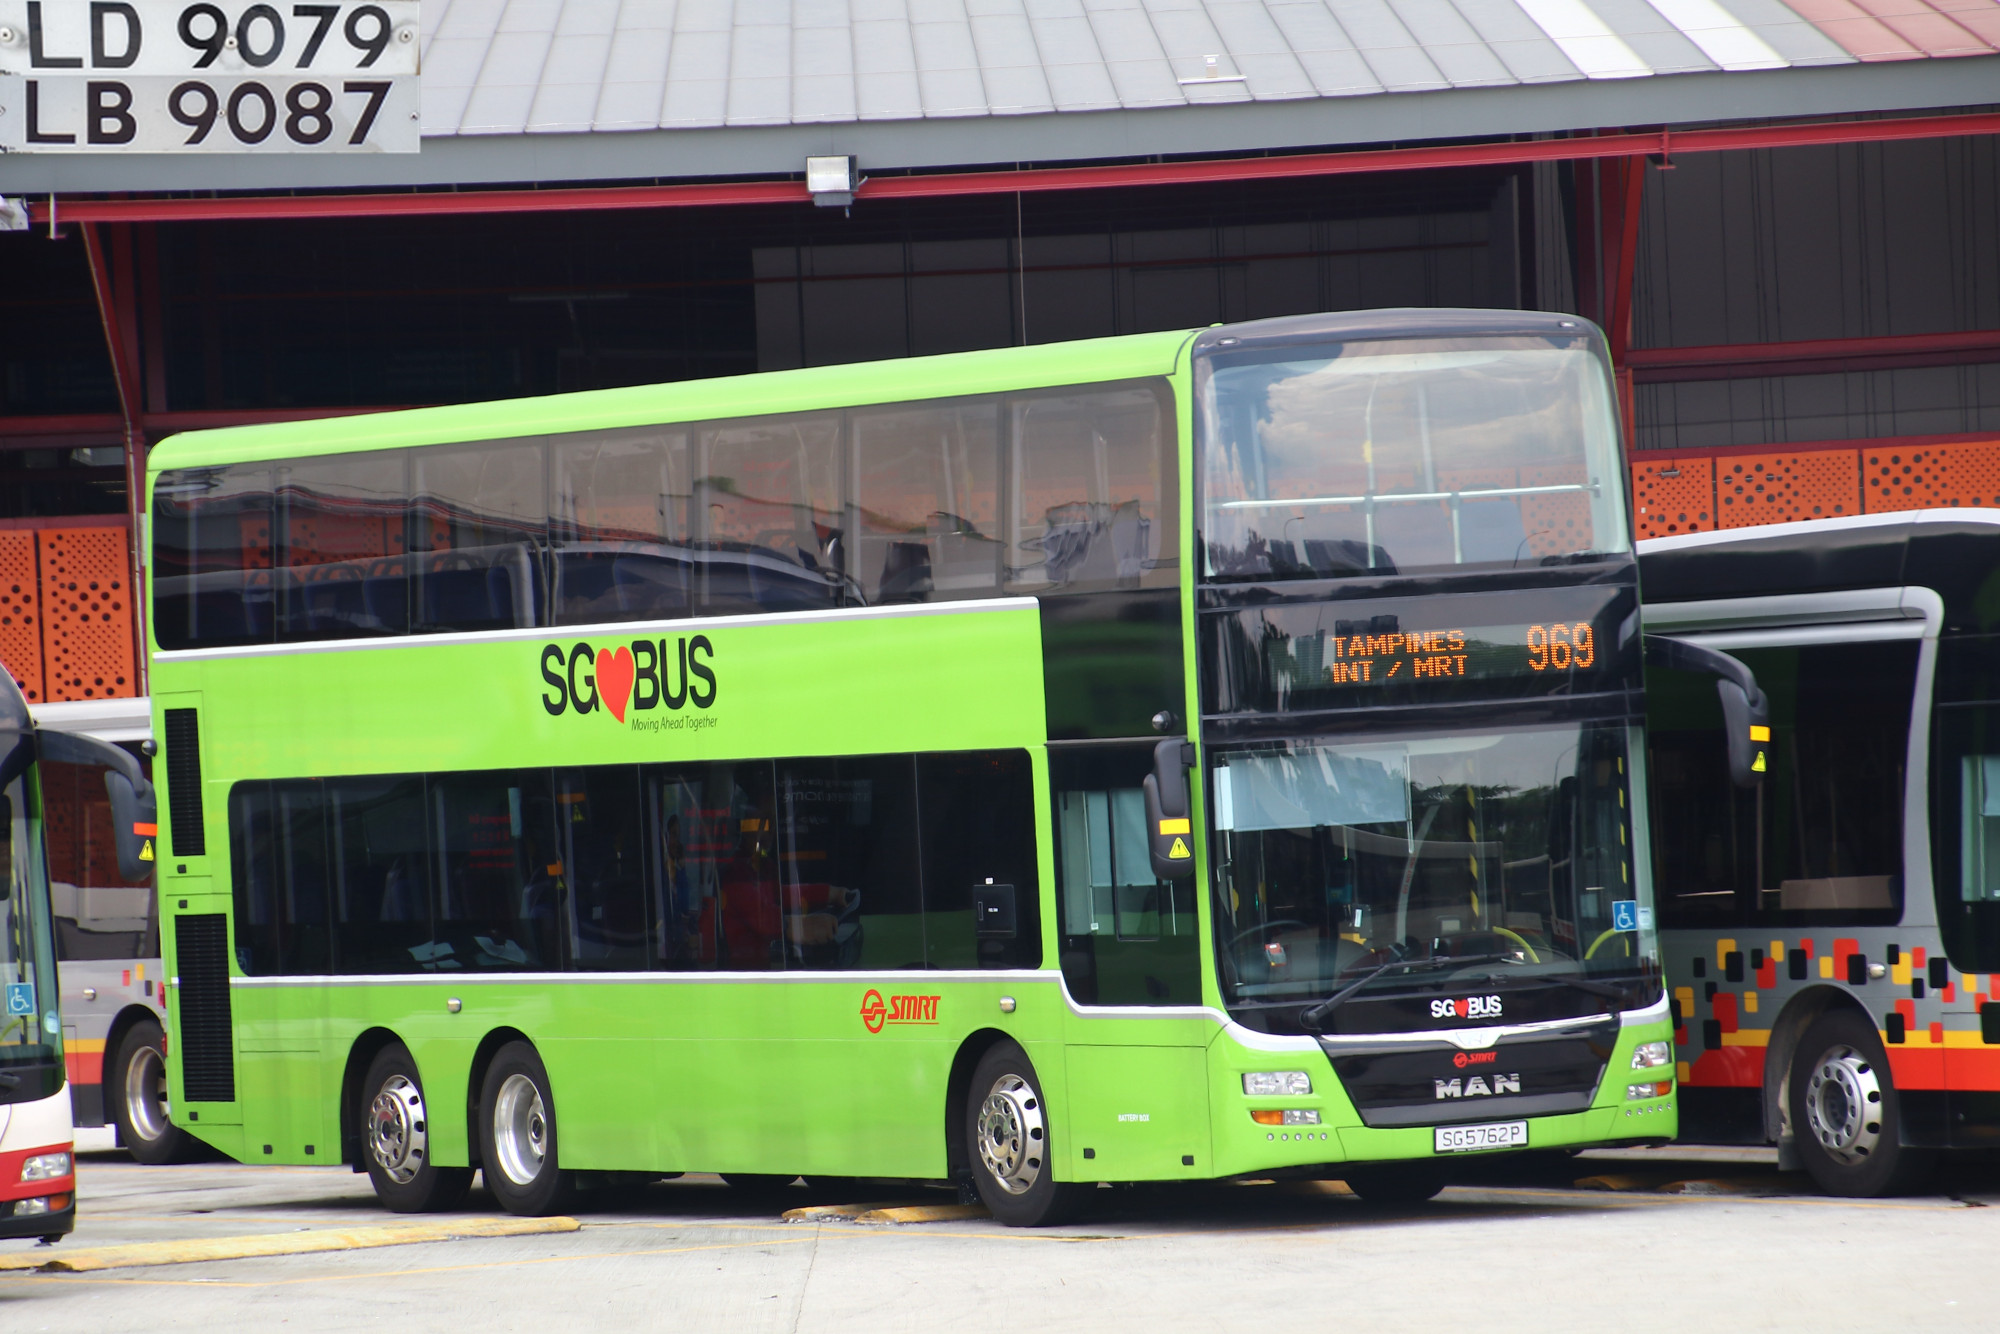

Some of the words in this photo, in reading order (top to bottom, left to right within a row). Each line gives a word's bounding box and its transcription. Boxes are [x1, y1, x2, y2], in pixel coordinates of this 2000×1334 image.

[1332, 630, 1465, 657] TAMPINES
[1527, 622, 1594, 671] 969
[1333, 661, 1373, 683] INT
[1387, 662, 1402, 677] /
[1413, 655, 1468, 678] MRT
[632, 717, 659, 733] Moving
[660, 716, 684, 730] Ahead
[685, 714, 718, 732] Together
[887, 996, 941, 1020] SMRT
[1467, 1051, 1498, 1064] SMRT
[1434, 1073, 1521, 1099] MAN
[1118, 1113, 1138, 1122] BATTERY
[1139, 1113, 1150, 1122] BOX
[1442, 1125, 1520, 1146] SG5762P
